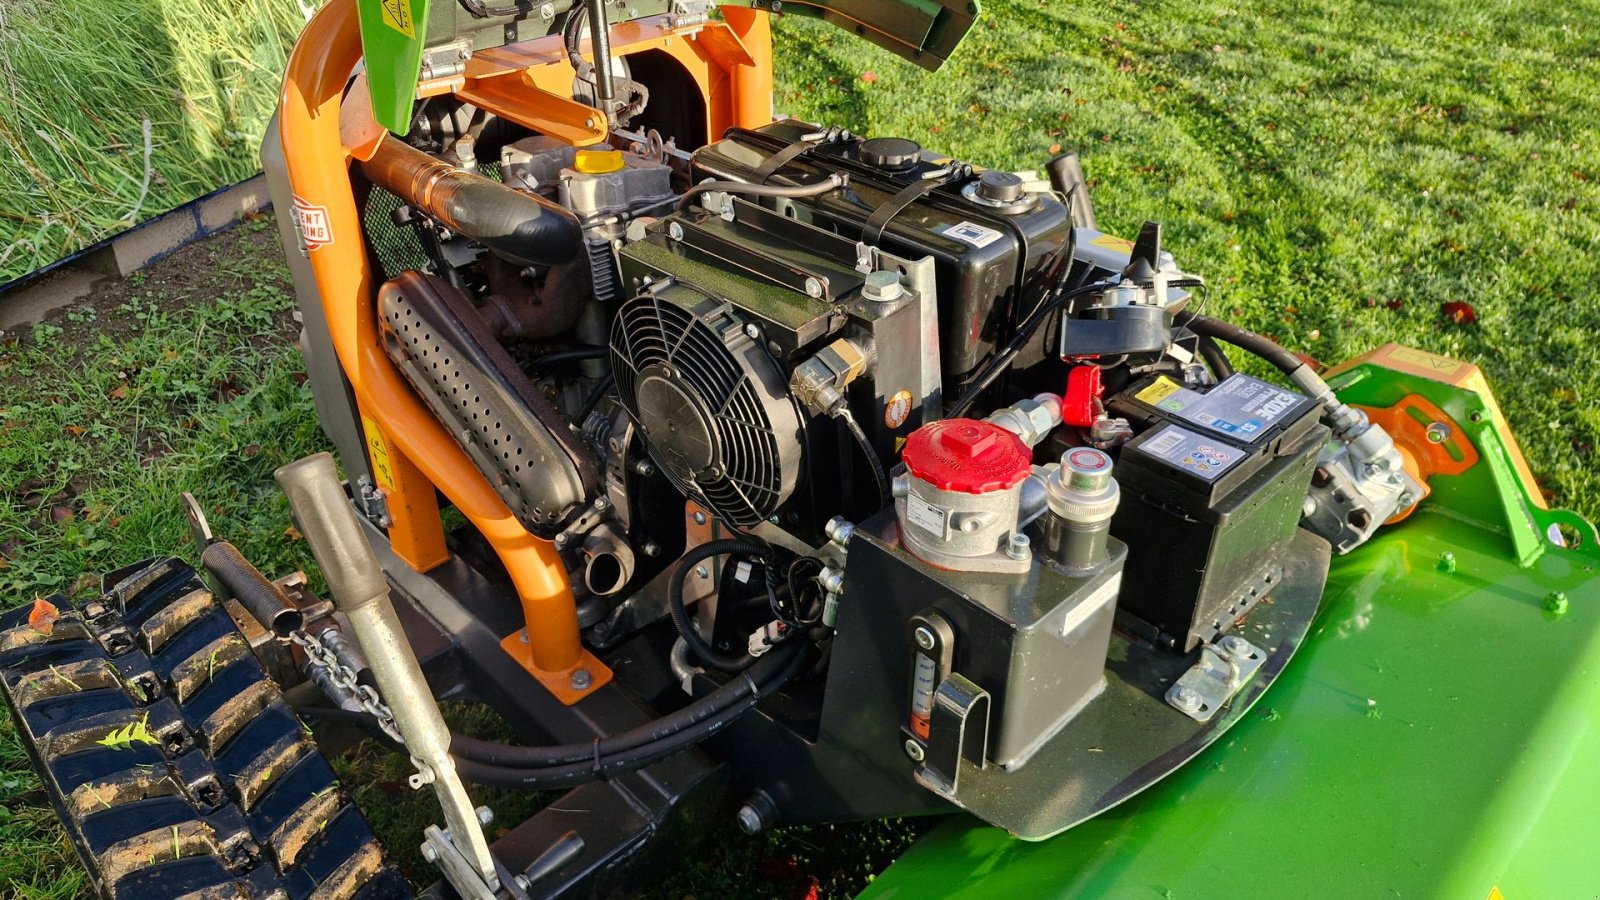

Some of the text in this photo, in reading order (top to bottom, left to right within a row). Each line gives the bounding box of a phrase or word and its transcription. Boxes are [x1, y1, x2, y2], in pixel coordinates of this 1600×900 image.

[401, 2, 409, 28] HOT
[1240, 388, 1280, 413] Premium
[1255, 392, 1297, 421] EXIDE
